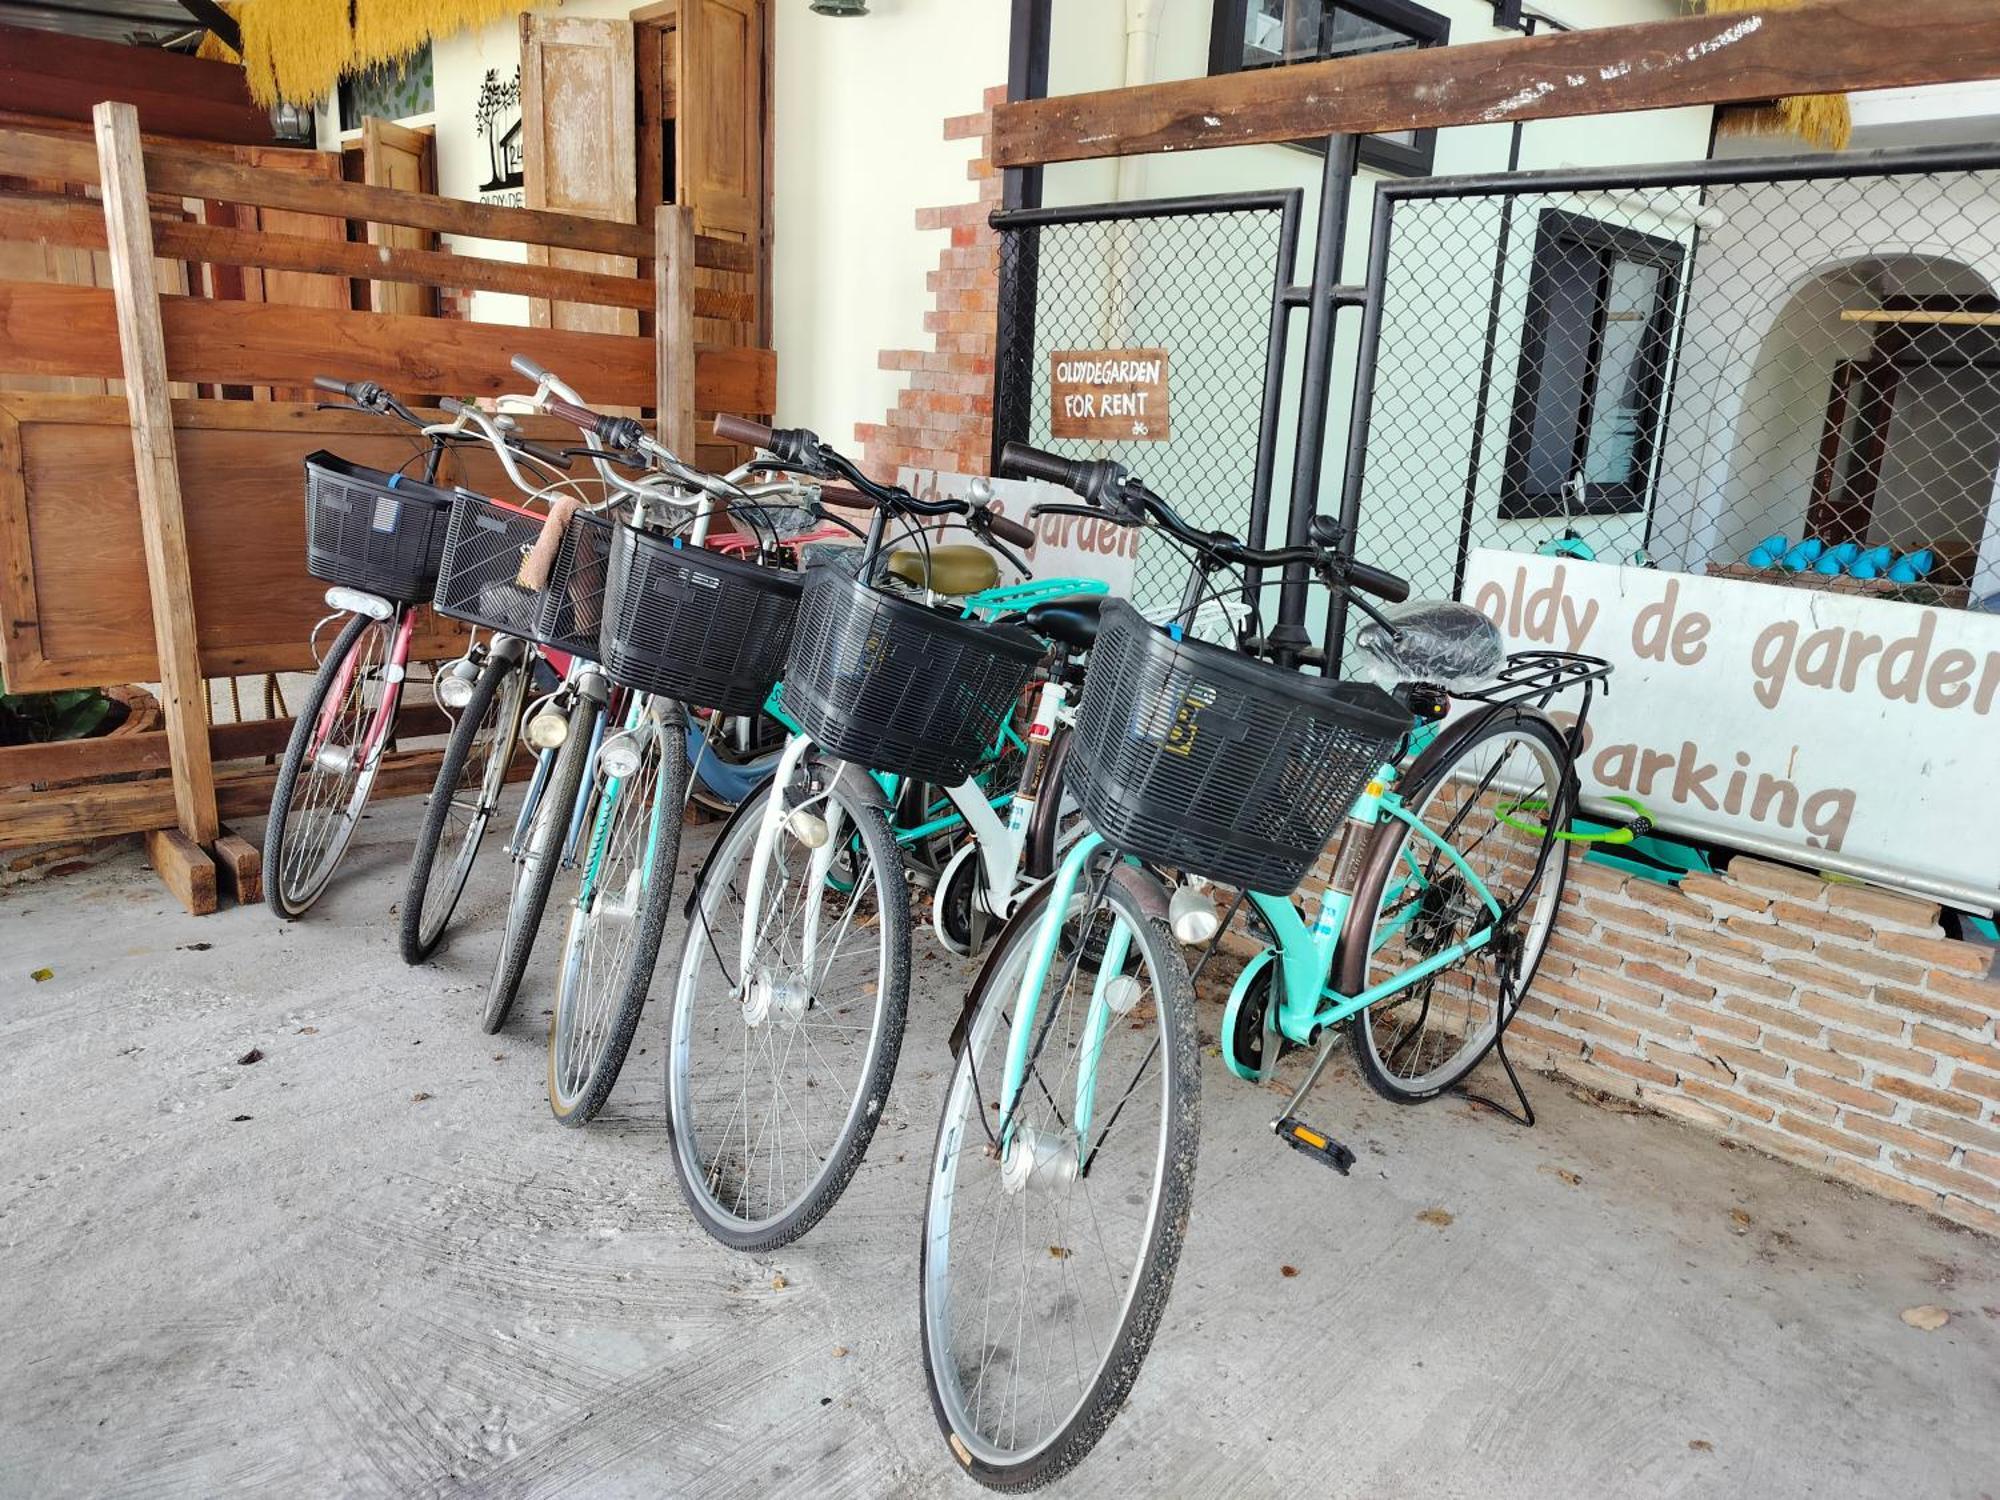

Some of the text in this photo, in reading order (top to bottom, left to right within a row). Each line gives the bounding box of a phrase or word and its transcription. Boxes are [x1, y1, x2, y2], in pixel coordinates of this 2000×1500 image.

[1056, 359, 1161, 385] OLDYDEGARDEN
[1064, 392, 1149, 418] FOR RENT
[1475, 564, 1599, 669] oldy
[1632, 578, 1711, 666] de
